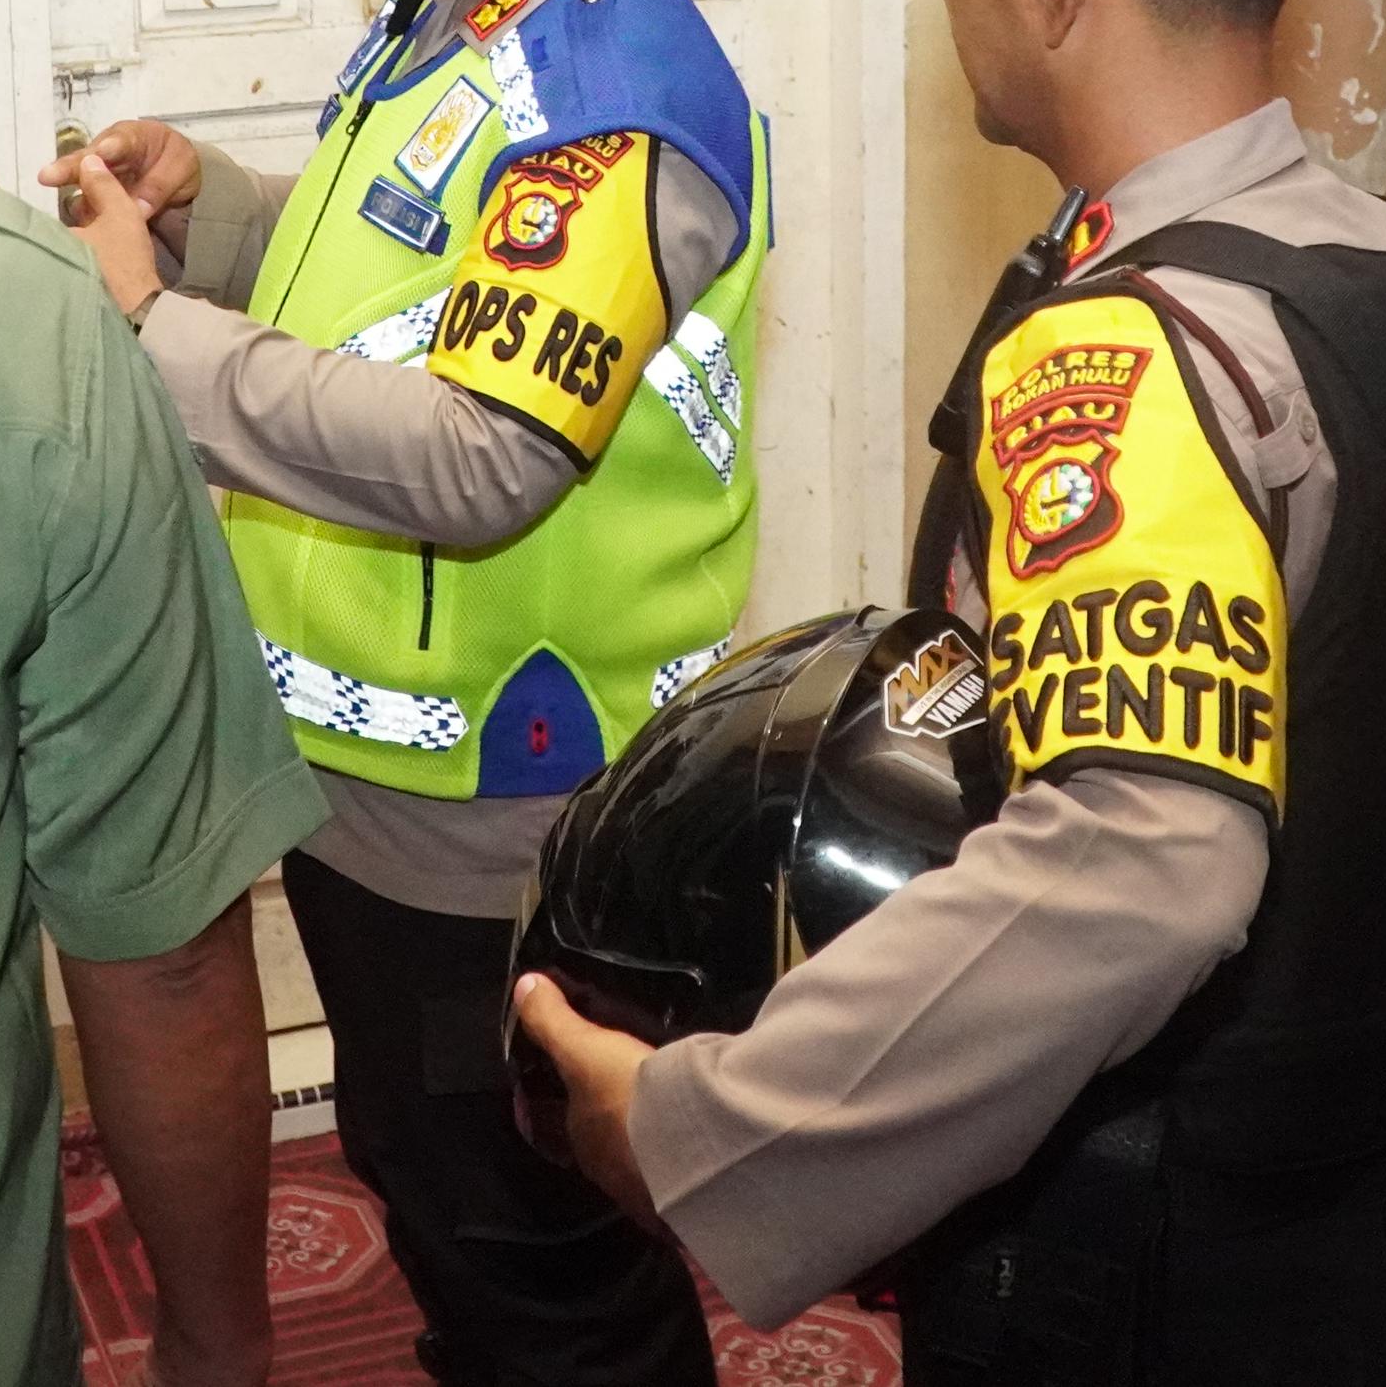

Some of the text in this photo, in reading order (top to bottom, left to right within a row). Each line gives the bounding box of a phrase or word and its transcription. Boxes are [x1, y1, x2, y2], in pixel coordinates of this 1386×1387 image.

[428, 280, 623, 407] OPS RES
[1001, 367, 1131, 419] ROKAN HULU
[1002, 350, 1137, 404] POLRES
[1005, 401, 1116, 449] RIAU
[991, 579, 1271, 692] SATGAS
